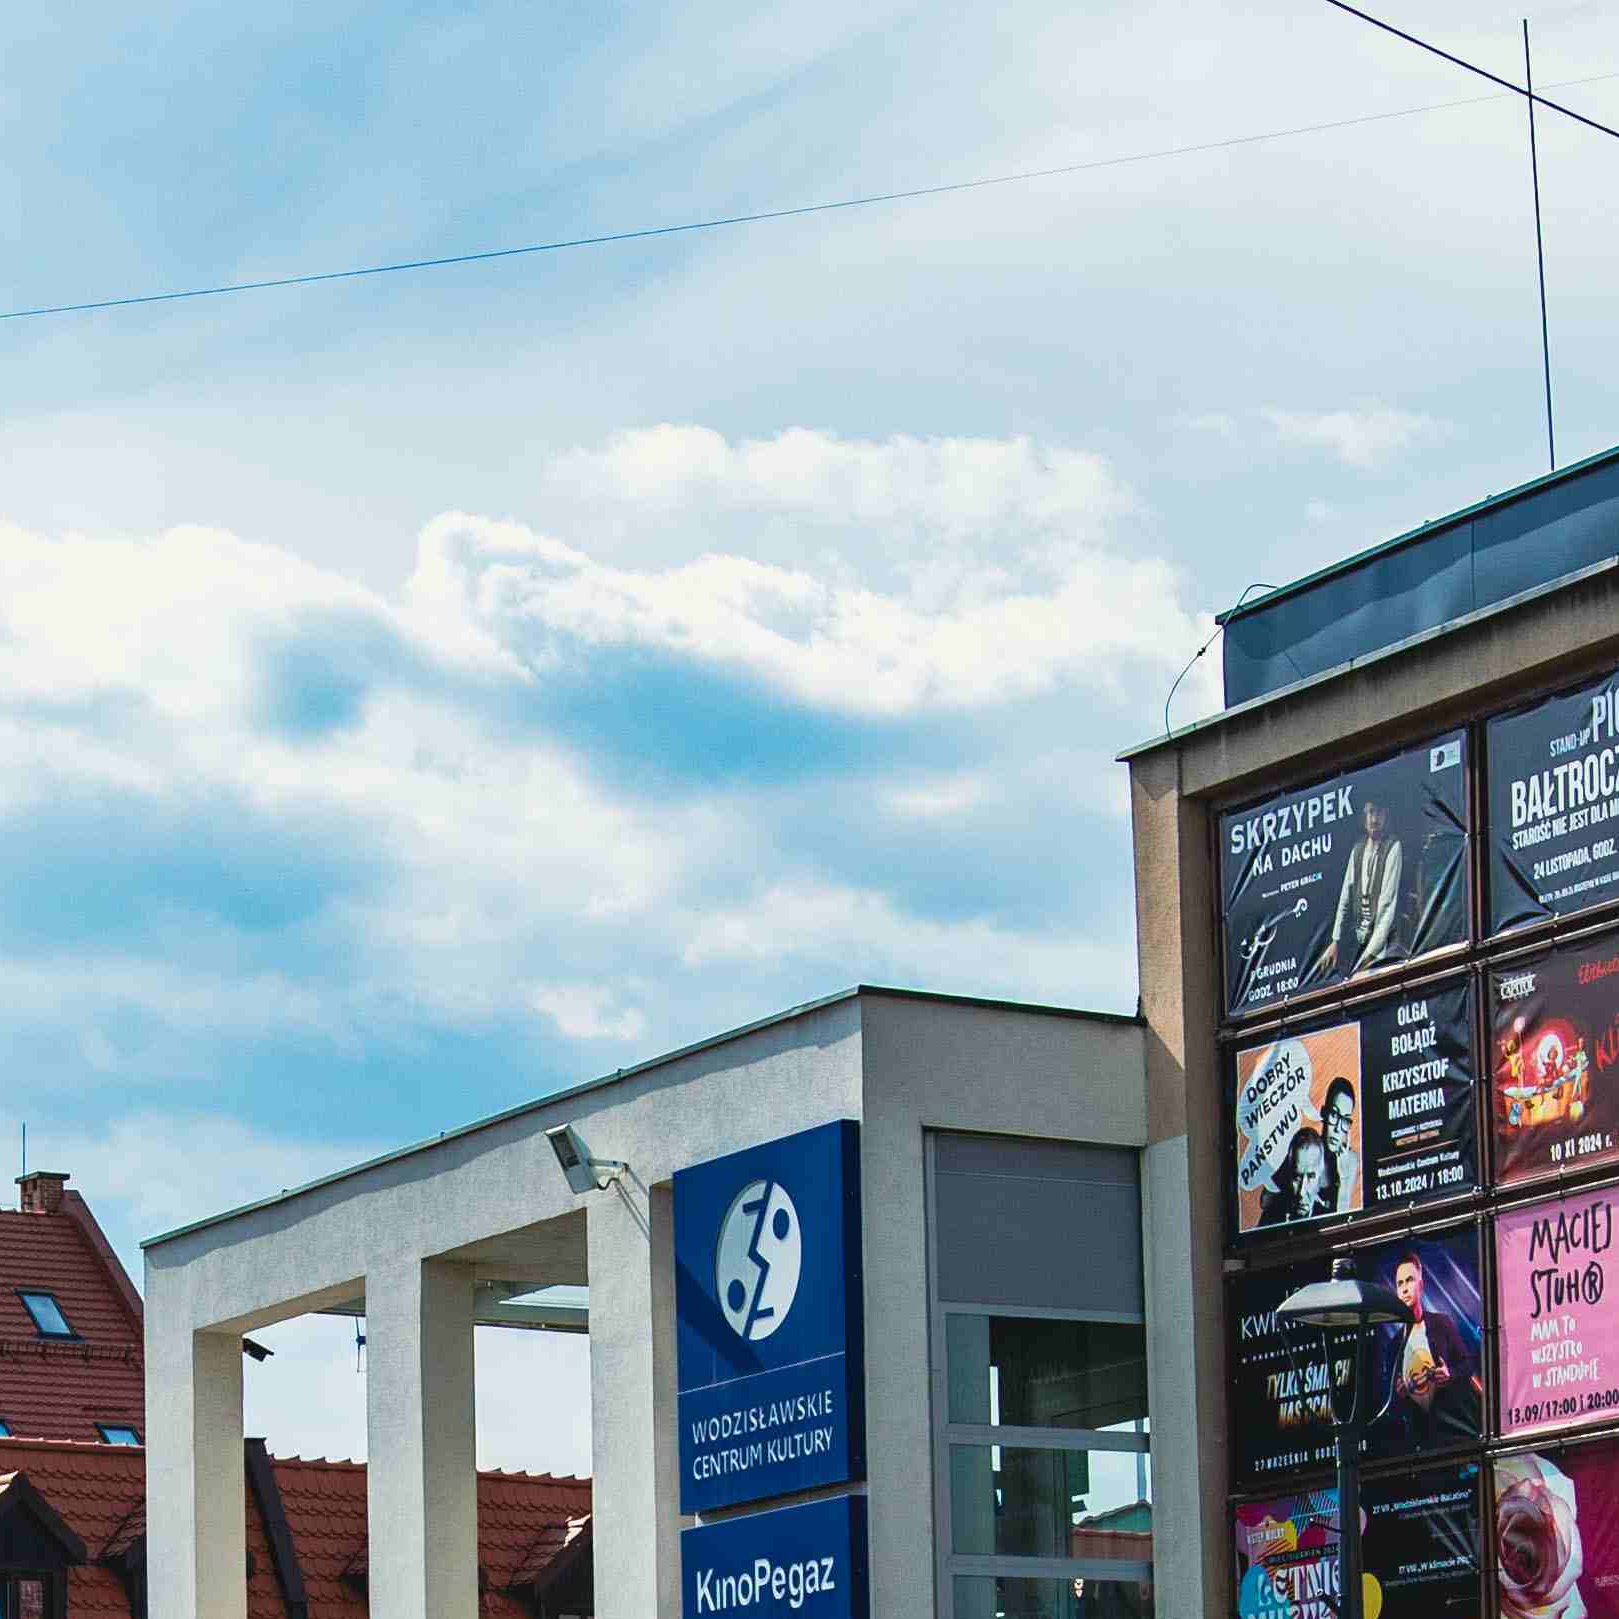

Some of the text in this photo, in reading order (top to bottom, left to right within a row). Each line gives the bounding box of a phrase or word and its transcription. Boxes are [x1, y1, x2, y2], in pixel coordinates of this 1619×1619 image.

[1550, 727, 1590, 757] STAND-UP
[1231, 785, 1353, 854] SKRZYPEK
[1512, 818, 1552, 850] STAROŚĆ
[1552, 815, 1568, 838] NIE
[1569, 807, 1589, 832] JEST
[1591, 801, 1609, 824] DLA
[1252, 833, 1332, 877] NA DACHU
[1533, 861, 1545, 880] 24
[1545, 846, 1592, 876] LISTOPADA,
[1256, 957, 1297, 979] GRUDNIA
[1397, 1000, 1428, 1026] OLGA
[1391, 1020, 1437, 1056] BOŁĄDŹ
[1246, 1052, 1292, 1104] DOBRY
[1382, 1058, 1450, 1093] KRZYSZTOF
[1245, 1066, 1306, 1129] WIECZÓR
[1388, 1087, 1445, 1120] MATERNA
[1241, 1104, 1298, 1185] PAŃSTWU
[1550, 1143, 1562, 1162] 10
[1564, 1137, 1575, 1159] XI
[1578, 1132, 1602, 1154] 2024
[1375, 1173, 1427, 1200] 13.10.2024
[1437, 1164, 1463, 1184] 18:00
[1529, 1201, 1612, 1264] MACIEJ
[1531, 1320, 1559, 1342] MAM
[1532, 1339, 1583, 1365] WSZYSTKO
[1544, 1357, 1599, 1387] STANDUPIE
[692, 1390, 833, 1445] WODZISŁAWSKIE
[1508, 1397, 1577, 1425] 13.09/17:00
[1587, 1388, 1619, 1409] 20:00
[693, 1426, 833, 1480] CENTRUM KULTURY
